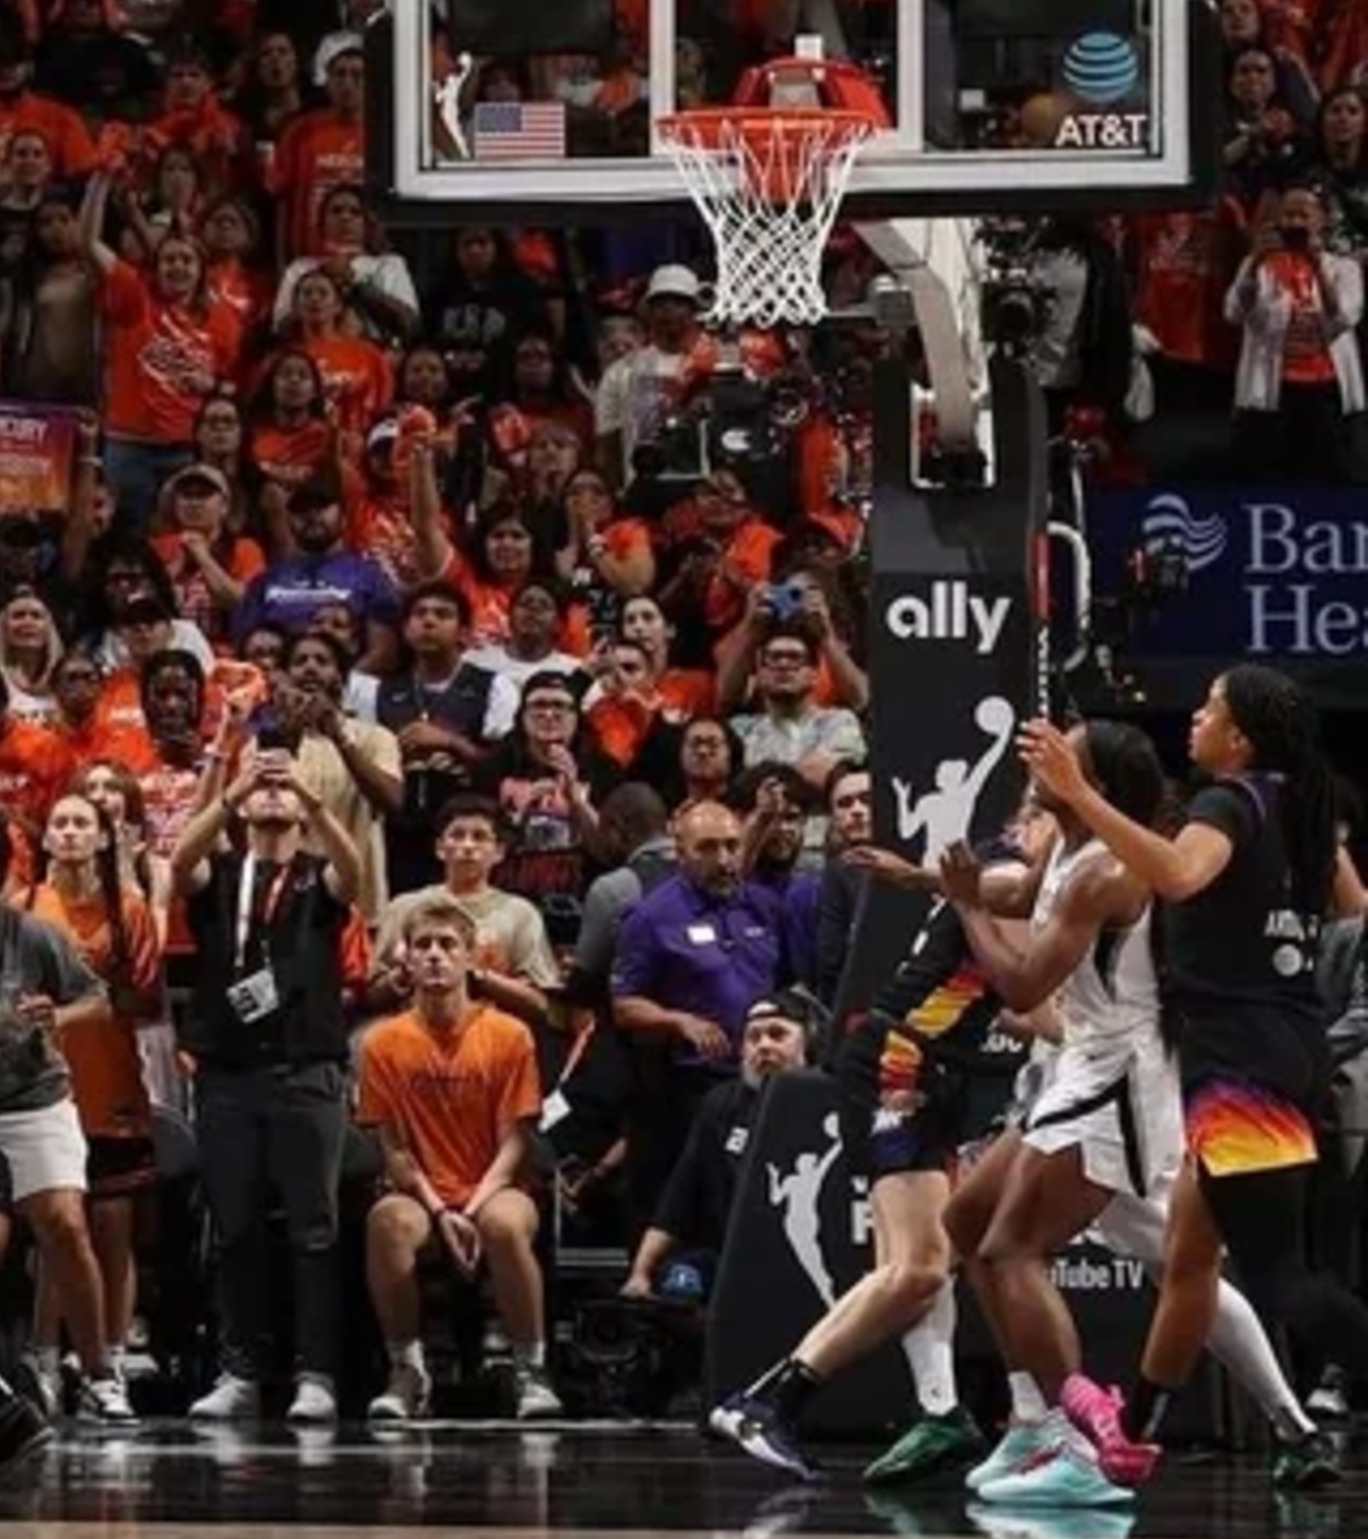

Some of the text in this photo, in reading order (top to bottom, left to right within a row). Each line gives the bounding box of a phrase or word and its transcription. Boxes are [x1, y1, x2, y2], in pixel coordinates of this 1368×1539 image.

[1054, 114, 1148, 147] AT&T
[886, 581, 1012, 654] ally
[1242, 585, 1368, 654] He
[1113, 1259, 1144, 1289] TV
